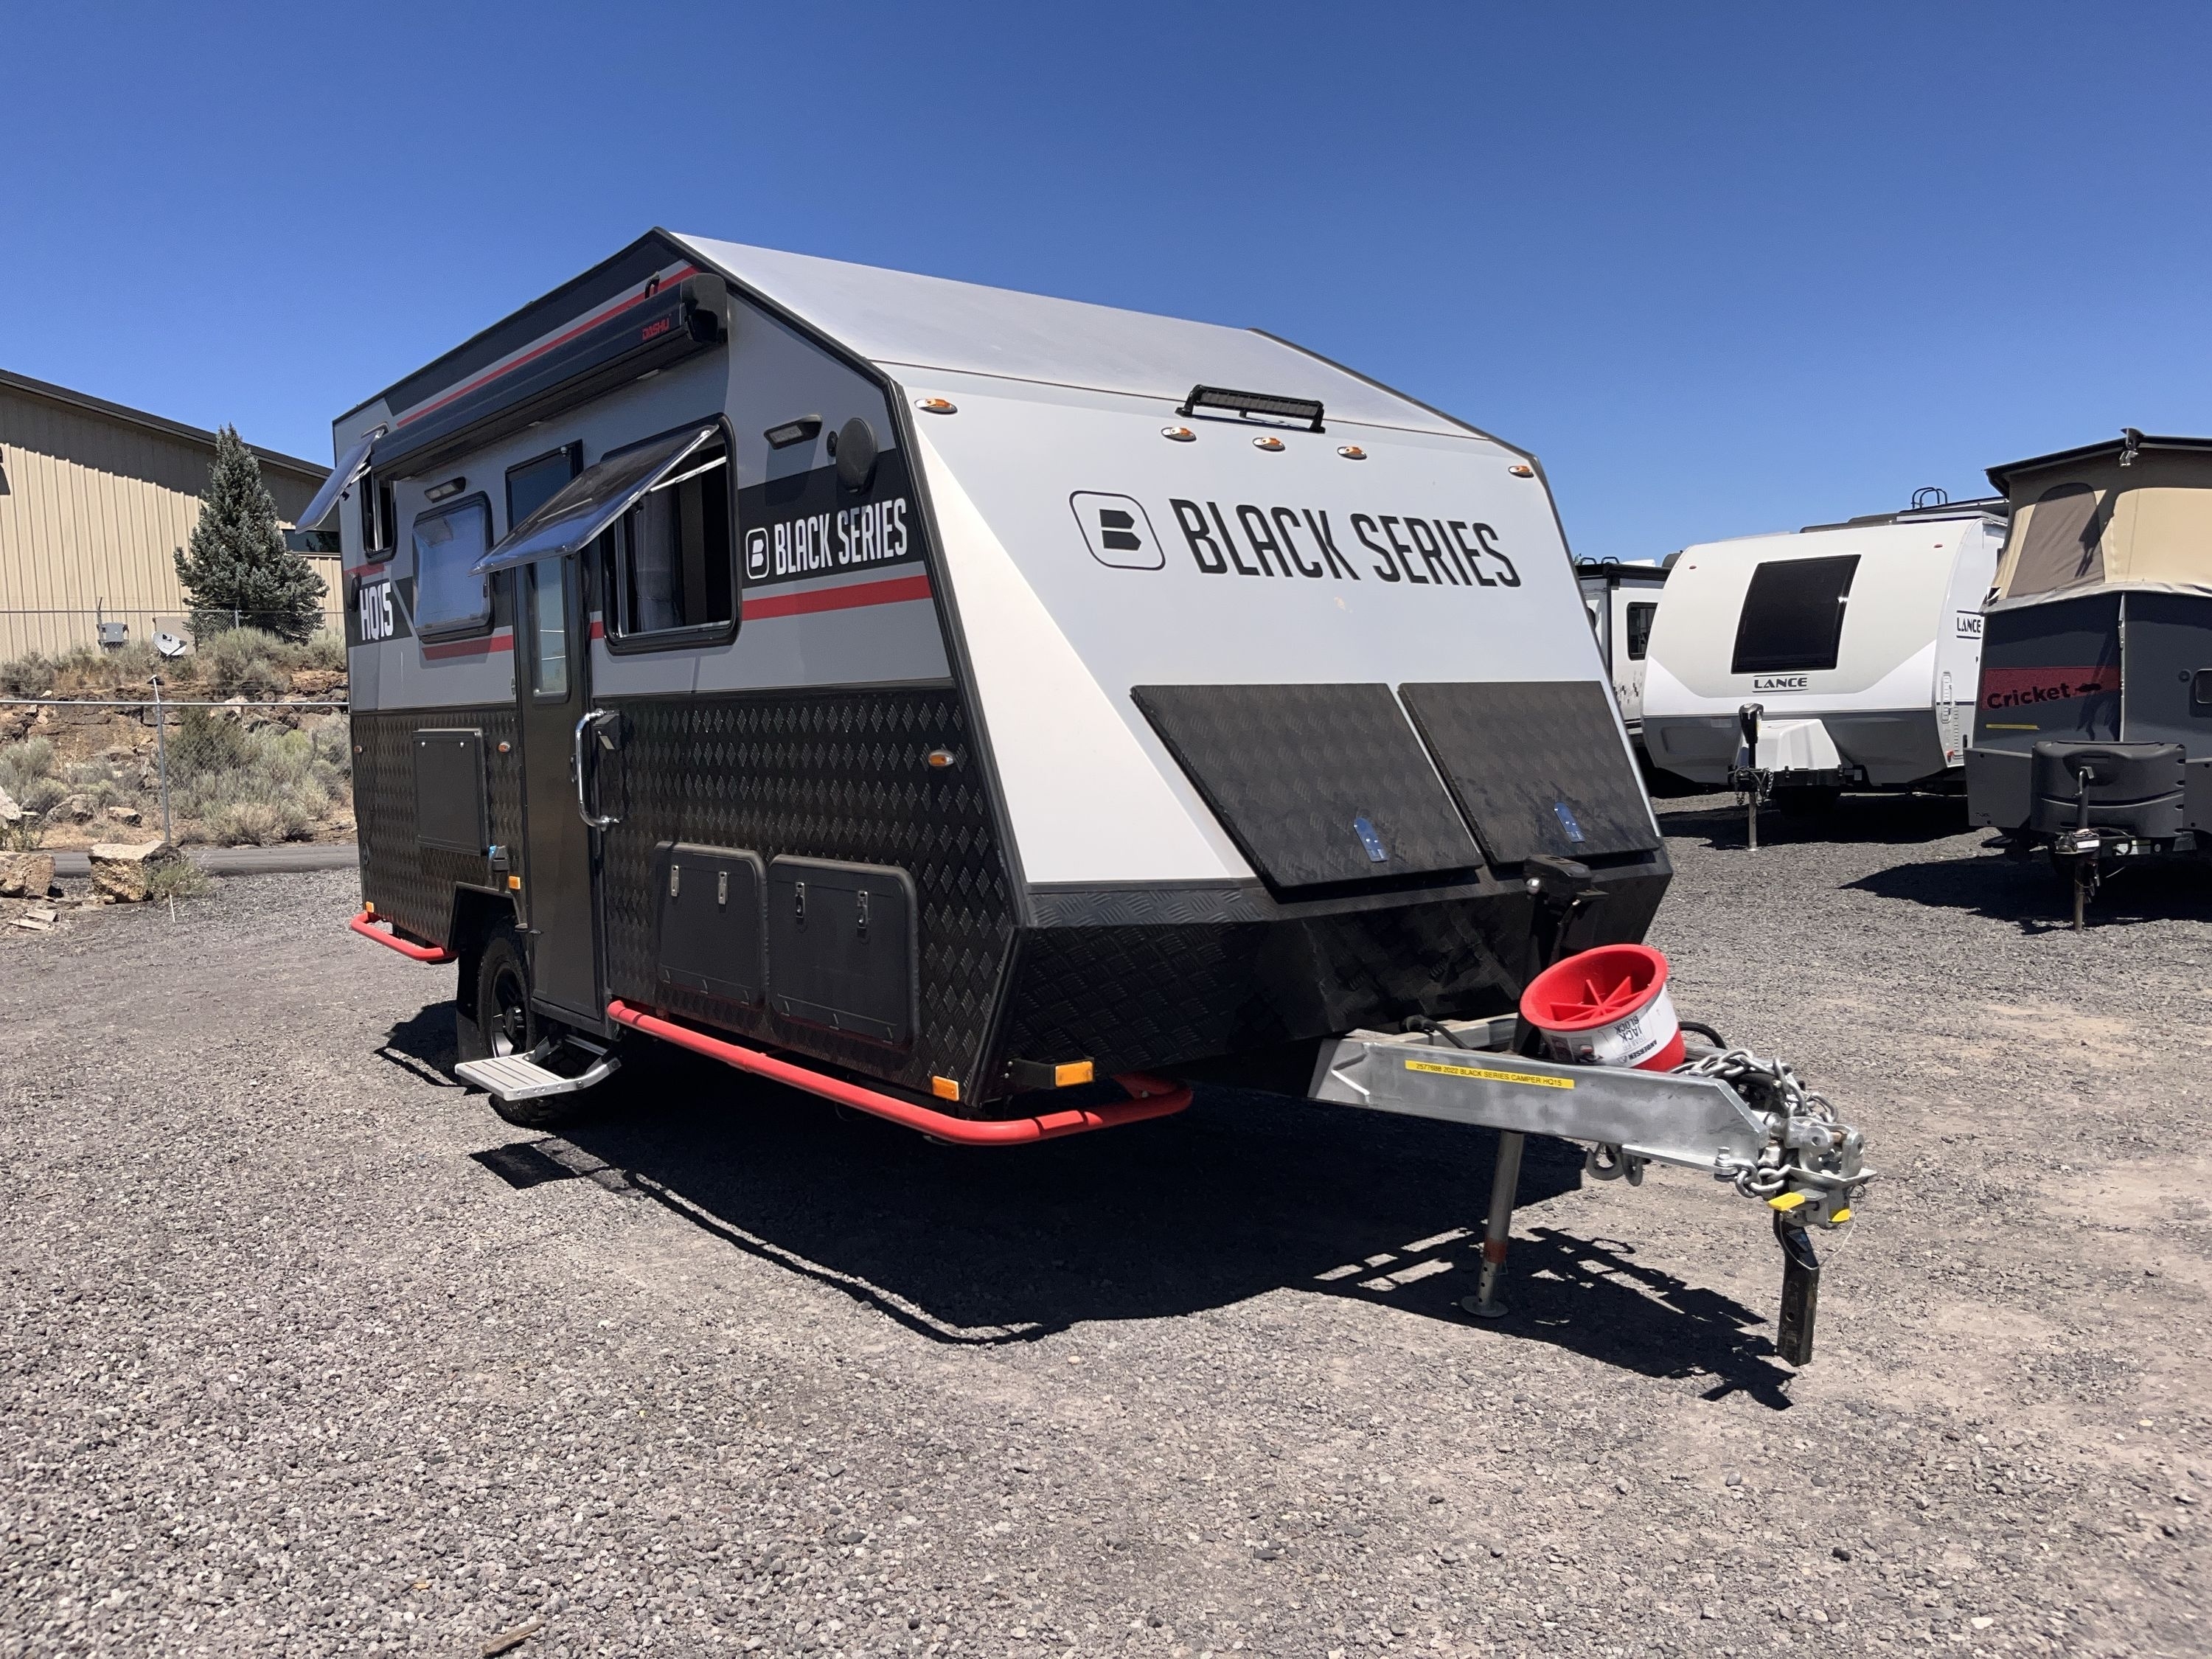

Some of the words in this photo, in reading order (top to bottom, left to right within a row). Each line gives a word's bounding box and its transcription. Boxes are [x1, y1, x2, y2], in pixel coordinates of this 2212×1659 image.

[774, 513, 832, 575] BLACK
[838, 498, 908, 565] SERIES
[1169, 498, 1360, 581] BLACK
[1350, 513, 1521, 588] SERIES
[360, 582, 393, 640] HQ15
[1957, 617, 1981, 633] LANCE
[1754, 678, 1807, 689] LANCE
[1987, 683, 2071, 709] Cricket
[1614, 1015, 1639, 1034] BLOCK
[1618, 1024, 1642, 1041] JACK
[1628, 1040, 1658, 1060] ANDERSEN
[1443, 1065, 1458, 1074] 2022
[1460, 1068, 1482, 1077] BLACK
[1484, 1071, 1509, 1080] SERIES
[1512, 1074, 1541, 1084] CAMPER
[1543, 1078, 1562, 1087] HQ15
